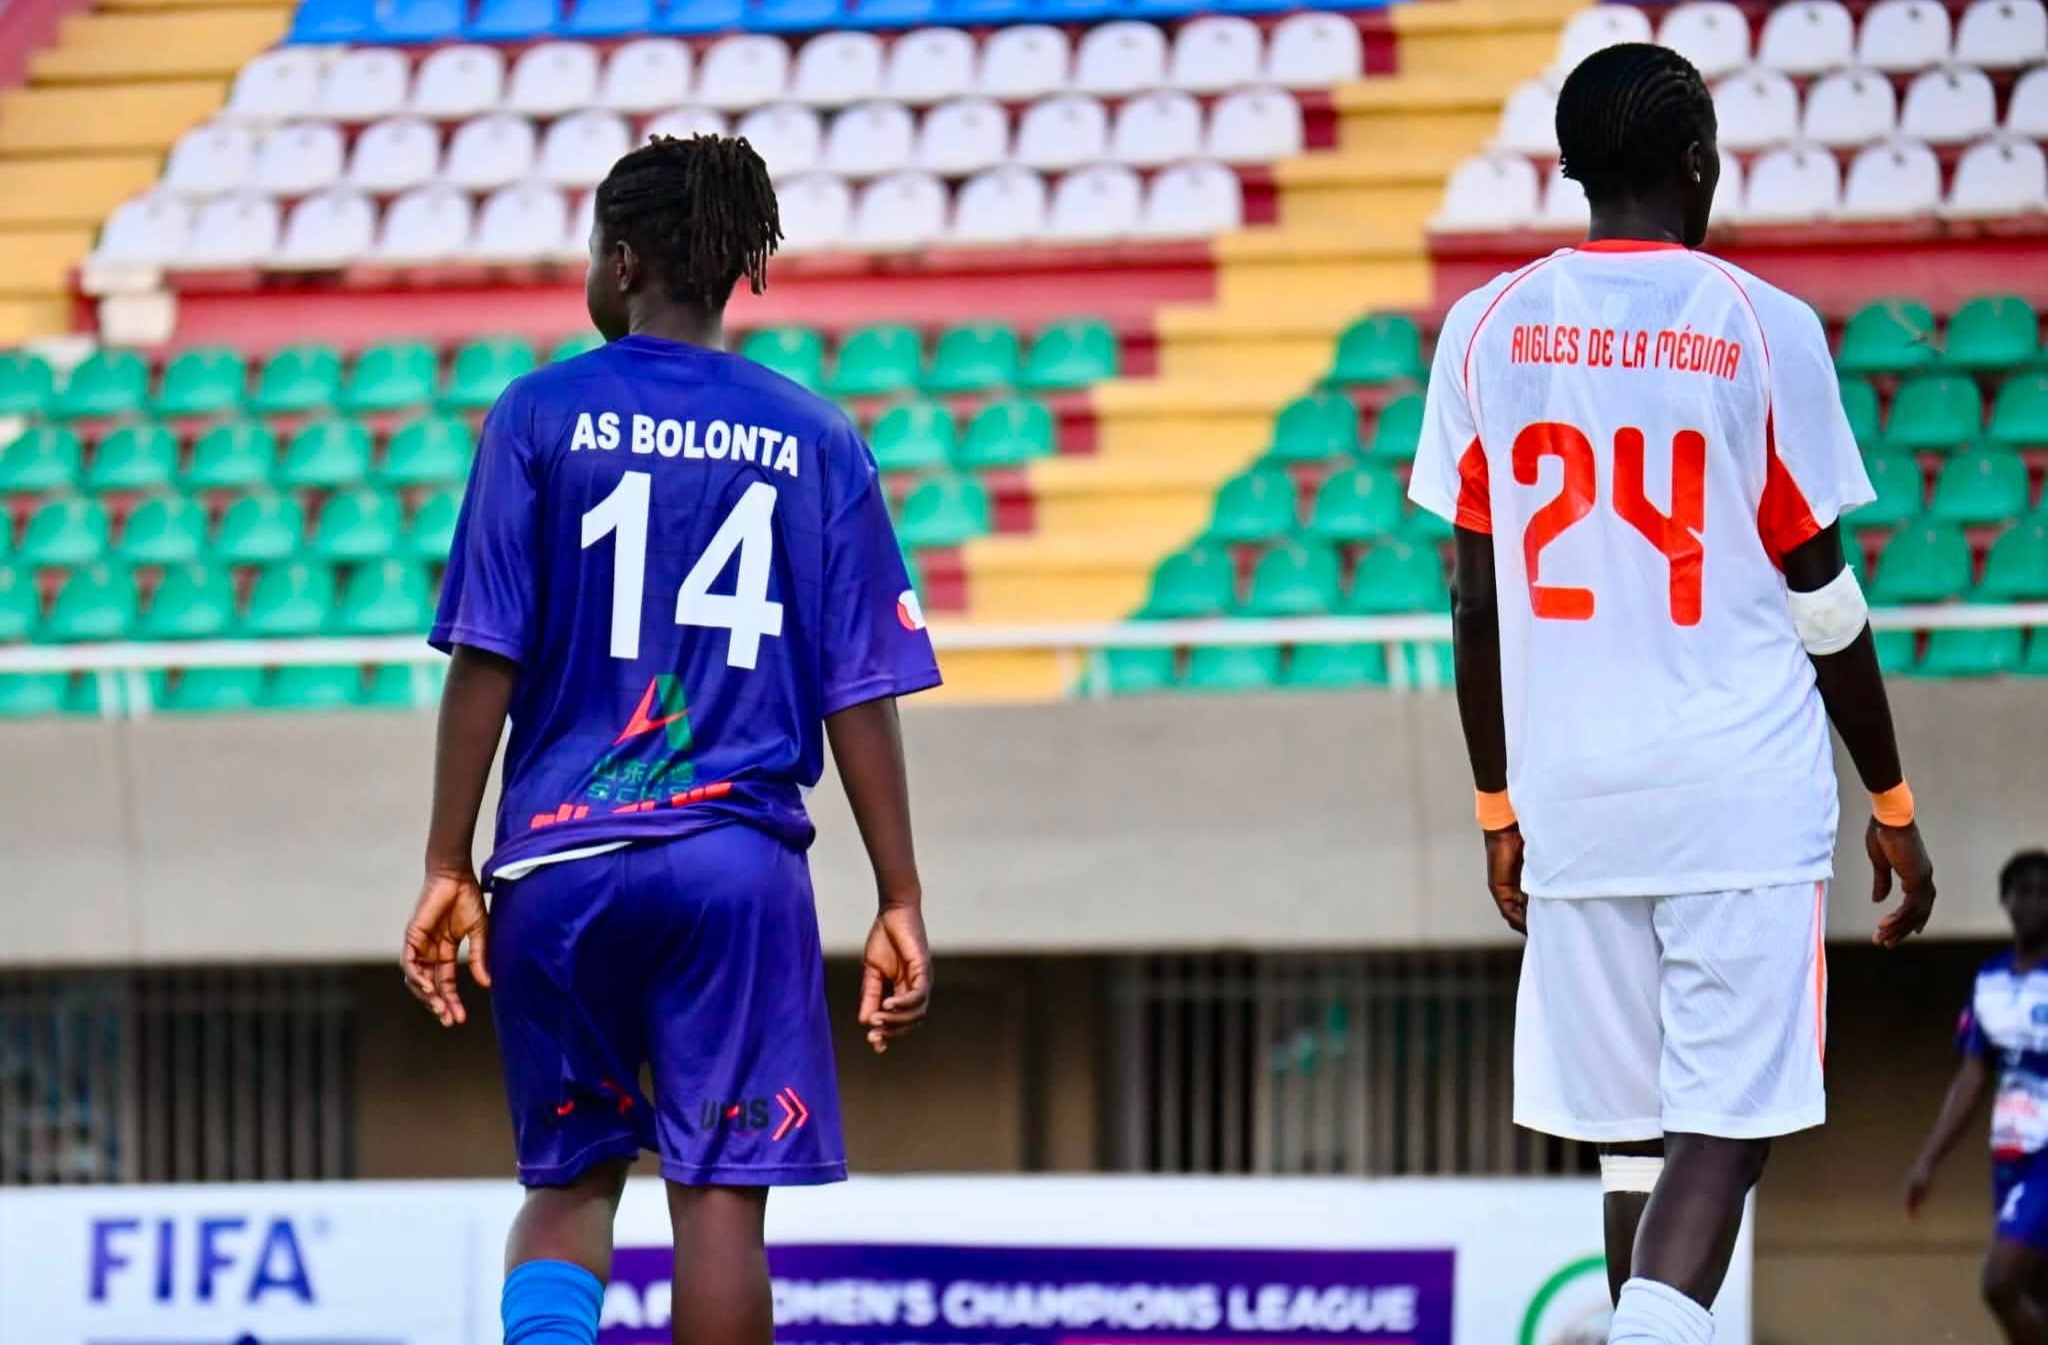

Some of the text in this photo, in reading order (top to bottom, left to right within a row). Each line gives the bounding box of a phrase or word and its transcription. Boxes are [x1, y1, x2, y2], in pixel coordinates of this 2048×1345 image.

[1511, 325, 1742, 381] AIGLES DE LA MÉDINA
[570, 412, 799, 478] AS BOLONTA
[1511, 421, 1707, 627] 24
[581, 470, 784, 670] 14
[87, 1216, 316, 1306] FIFA
[772, 1279, 938, 1326] OMEN'S
[941, 1281, 1222, 1330] CHAMPIONS
[1226, 1284, 1418, 1332] LEAGUE
